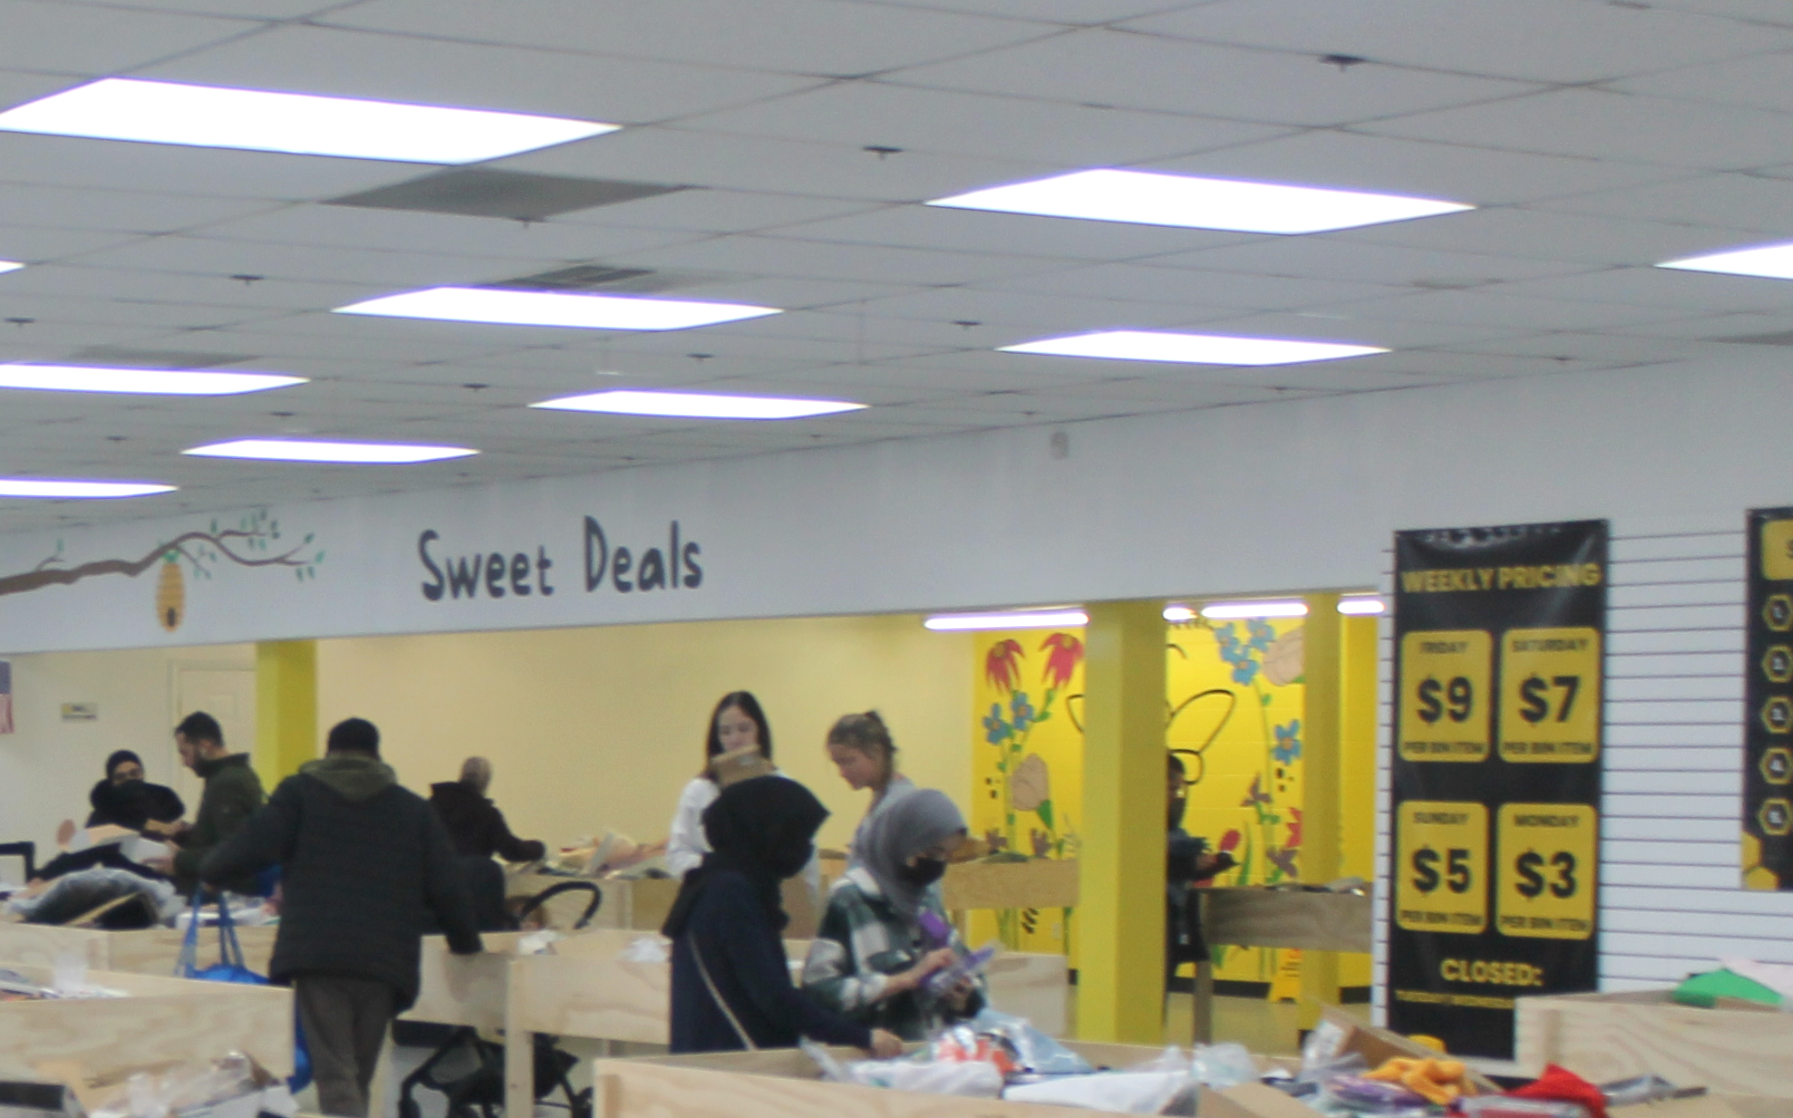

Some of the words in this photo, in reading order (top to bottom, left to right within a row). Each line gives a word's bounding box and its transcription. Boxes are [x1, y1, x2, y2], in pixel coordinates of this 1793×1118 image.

[418, 529, 554, 601] Sweet
[584, 514, 703, 592] Deals
[1400, 567, 1494, 593] WEEKLY
[1498, 562, 1602, 591] PRICING
[1420, 641, 1469, 654] FRIDAY
[1511, 638, 1589, 653] SATURDAY
[1417, 674, 1473, 727] $9
[1520, 672, 1581, 727] $7
[1404, 741, 1427, 754] PER
[1430, 741, 1451, 754] BIN
[1455, 741, 1485, 754] ITEM
[1504, 741, 1527, 755] PER
[1531, 741, 1555, 755] BIN
[1561, 741, 1593, 755] ITEM
[1413, 812, 1469, 825] SUNDAY
[1514, 815, 1581, 828] MONDAY
[1412, 844, 1471, 897] $5
[1515, 848, 1577, 901] $3
[1400, 910, 1424, 923] PER
[1425, 911, 1448, 925] BIN
[1452, 913, 1484, 926] ITEM
[1501, 915, 1527, 928] PER
[1530, 917, 1552, 930] BIN
[1558, 918, 1588, 931] ITEM
[1439, 958, 1544, 987] CLOSED:
